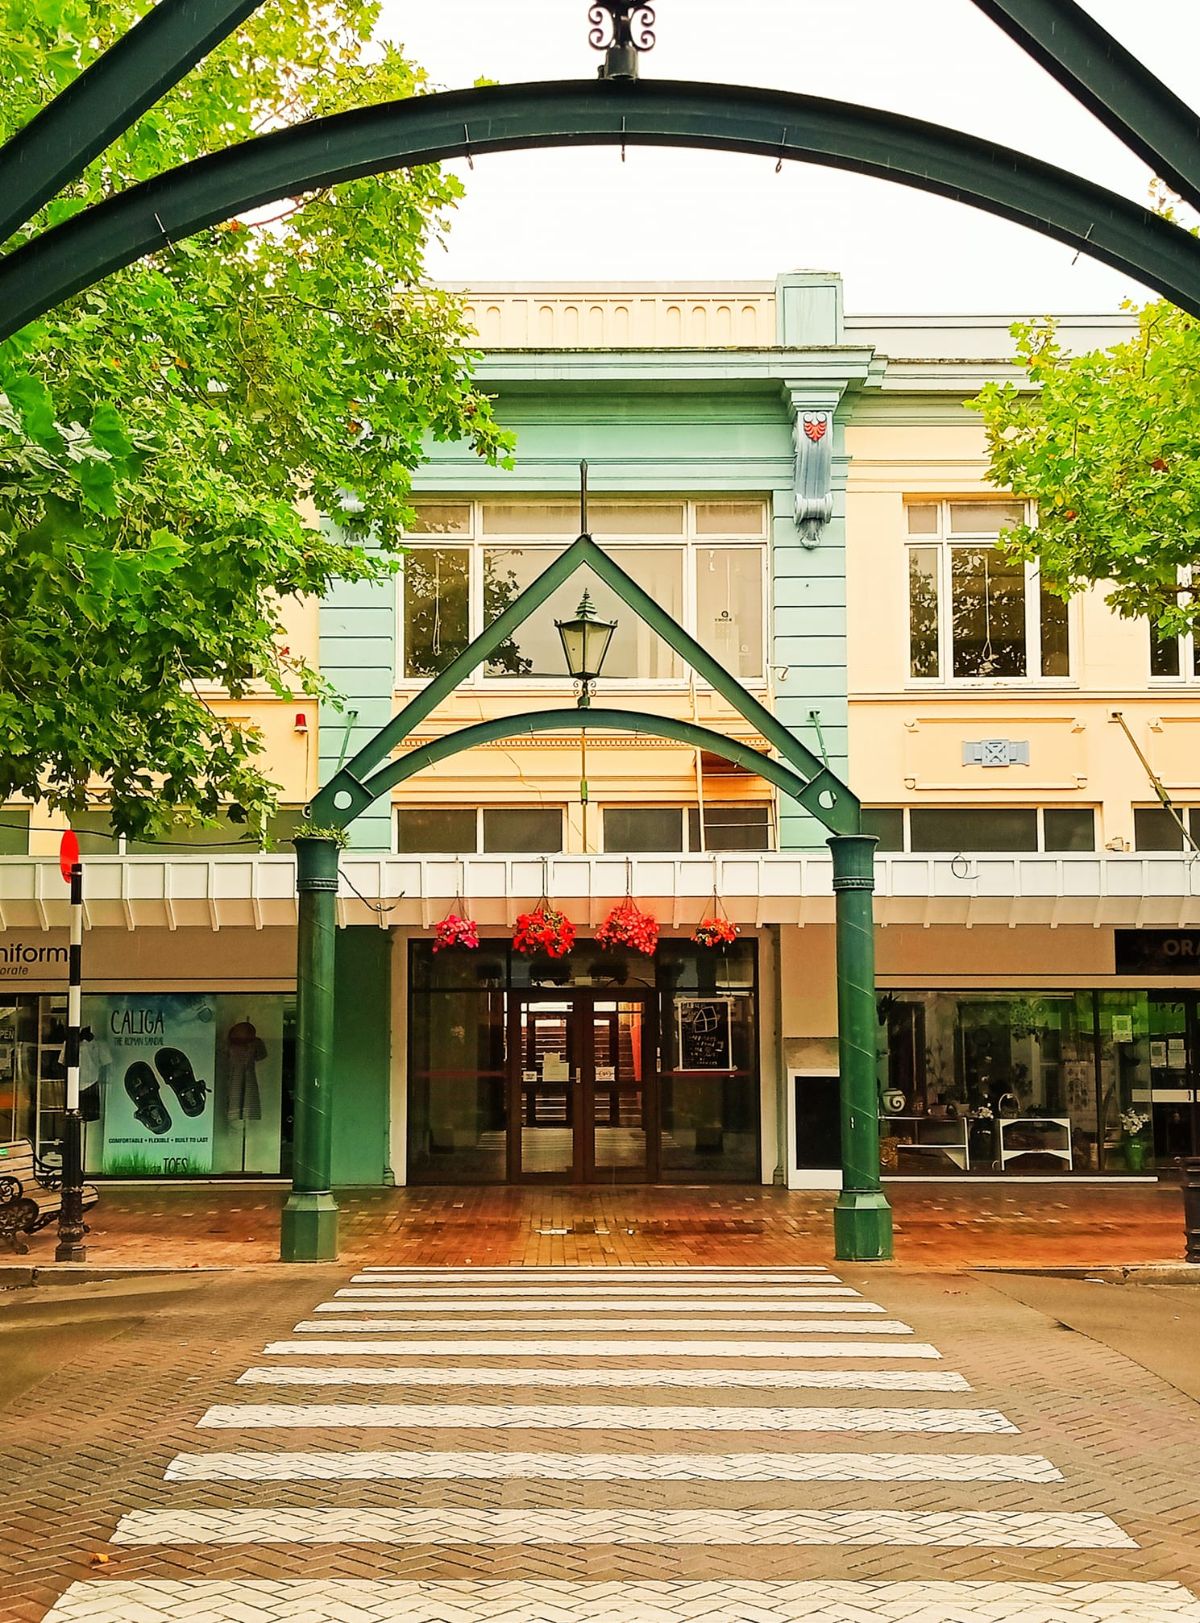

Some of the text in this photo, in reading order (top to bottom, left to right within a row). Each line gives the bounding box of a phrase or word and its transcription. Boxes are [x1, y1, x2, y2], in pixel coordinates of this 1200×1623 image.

[0, 943, 70, 963] niform
[111, 1010, 164, 1034] CALIGA
[163, 1157, 188, 1174] TOES
